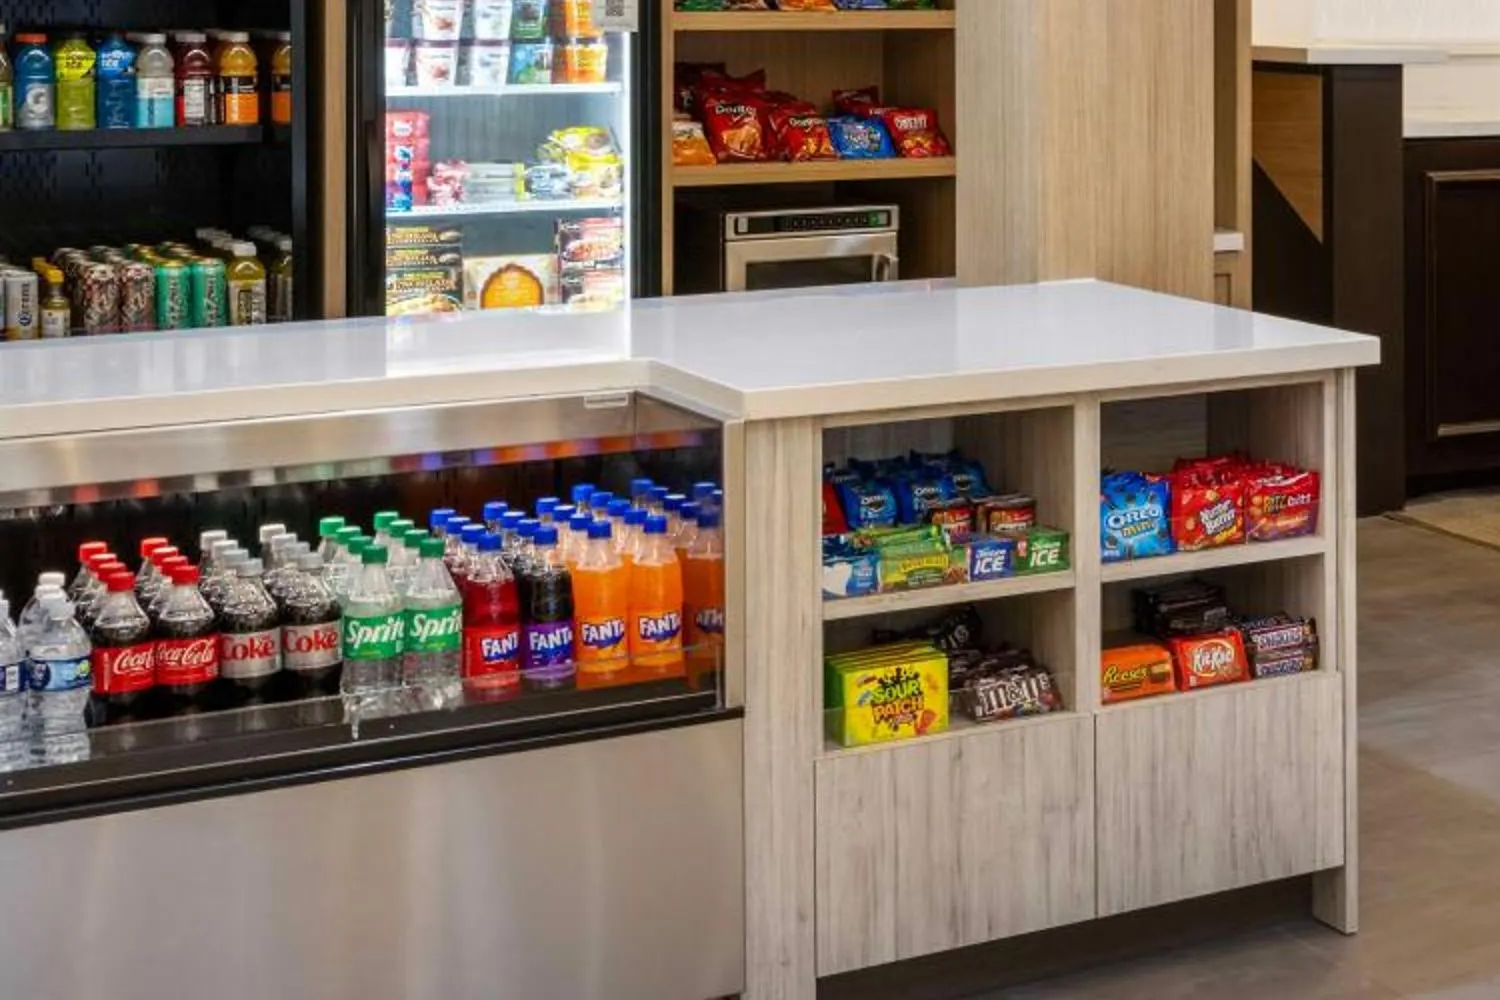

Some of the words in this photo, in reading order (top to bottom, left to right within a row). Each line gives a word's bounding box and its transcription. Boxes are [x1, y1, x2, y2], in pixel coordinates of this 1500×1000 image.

[1108, 506, 1161, 529] OREO
[974, 555, 1006, 576] ICE
[1030, 548, 1059, 568] ICE
[346, 617, 404, 645] Sprit
[529, 626, 574, 652] FANT
[482, 631, 519, 658] FANT
[871, 680, 921, 703] SOUR
[872, 695, 924, 723] PATCH
